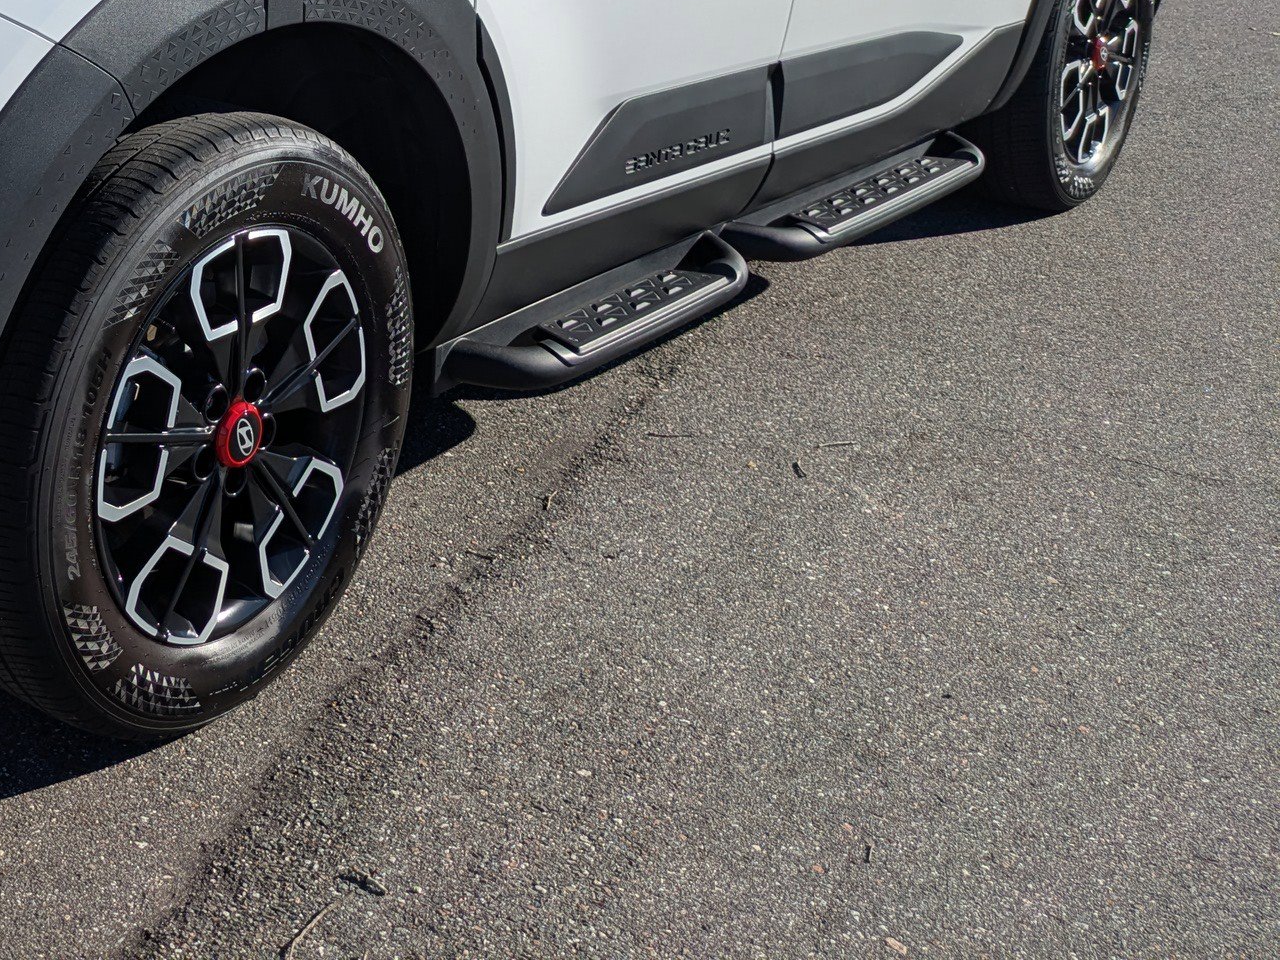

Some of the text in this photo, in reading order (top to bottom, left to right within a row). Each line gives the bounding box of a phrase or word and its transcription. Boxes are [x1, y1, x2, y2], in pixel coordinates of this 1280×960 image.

[625, 128, 730, 174] SANTA CRUZ
[301, 172, 385, 254] KUMHO
